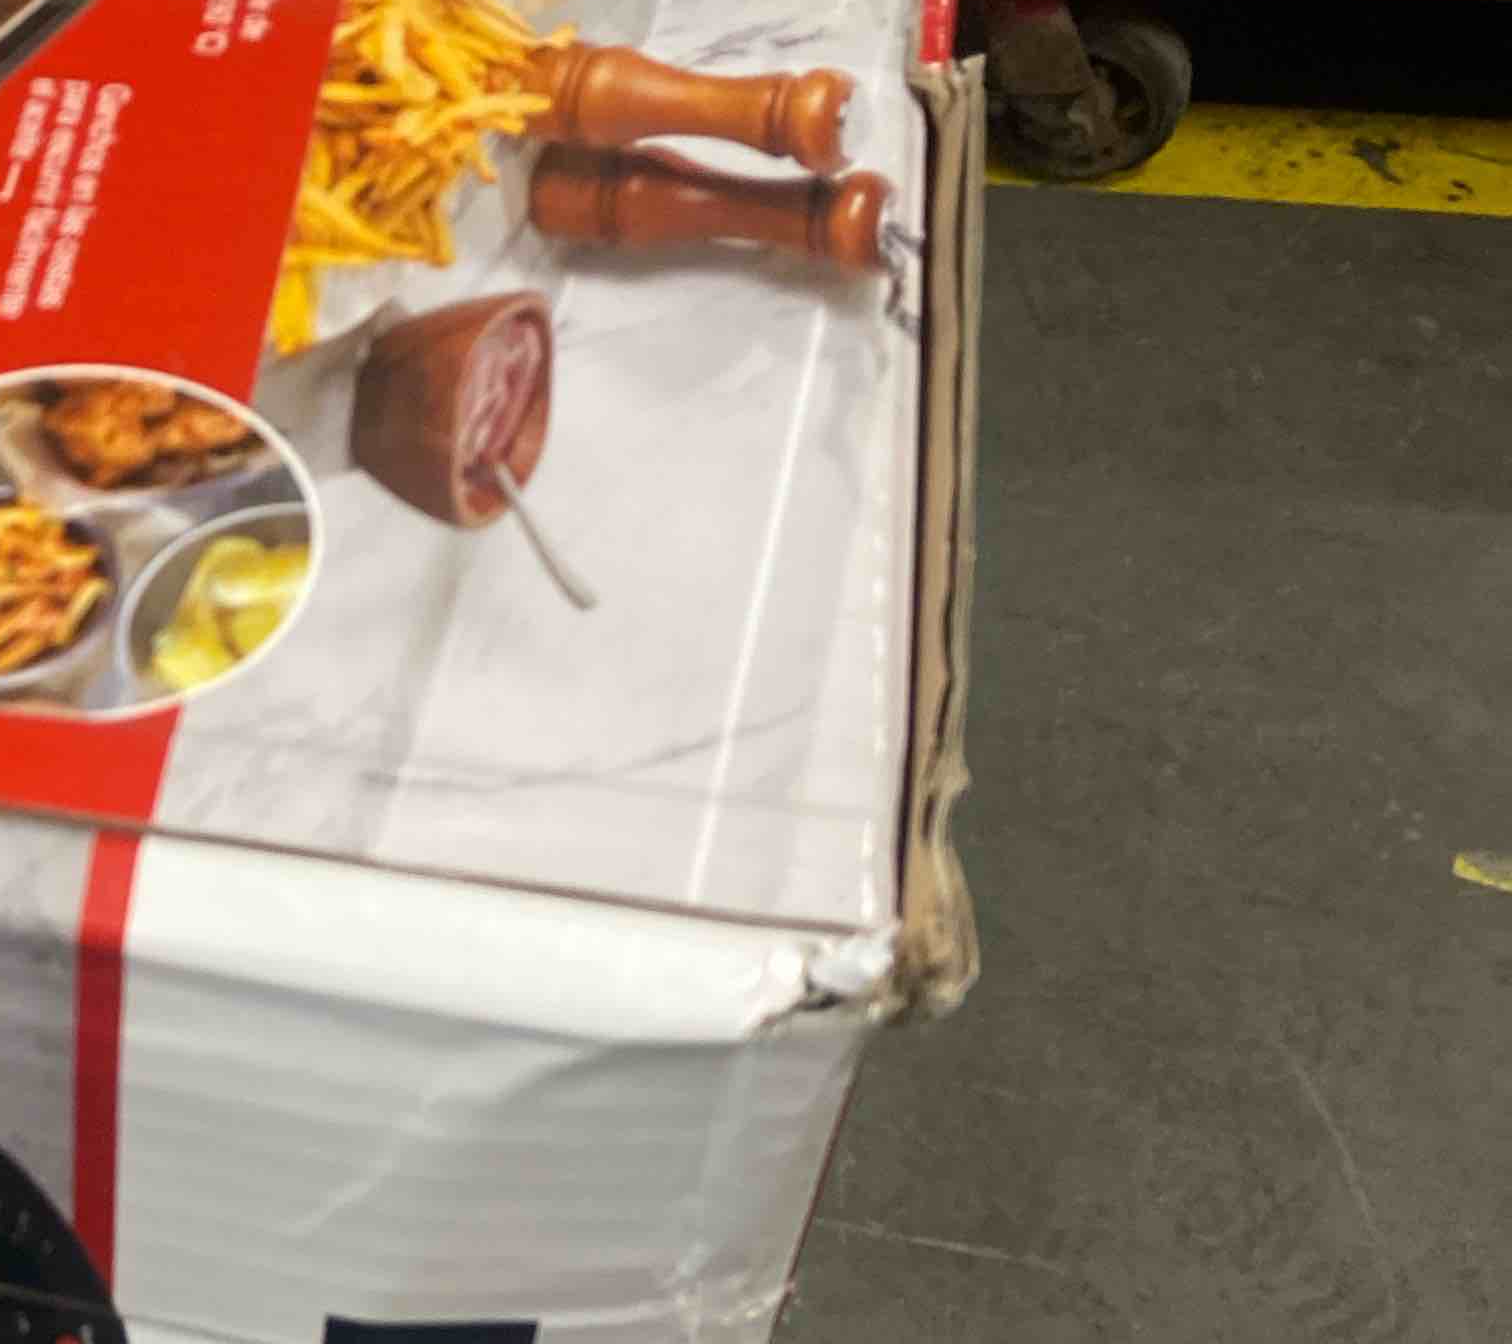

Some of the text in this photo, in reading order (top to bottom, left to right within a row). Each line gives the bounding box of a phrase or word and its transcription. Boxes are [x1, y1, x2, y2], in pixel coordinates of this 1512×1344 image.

[239, 11, 269, 41] de
[37, 83, 131, 309] Ganchos en las cestas
